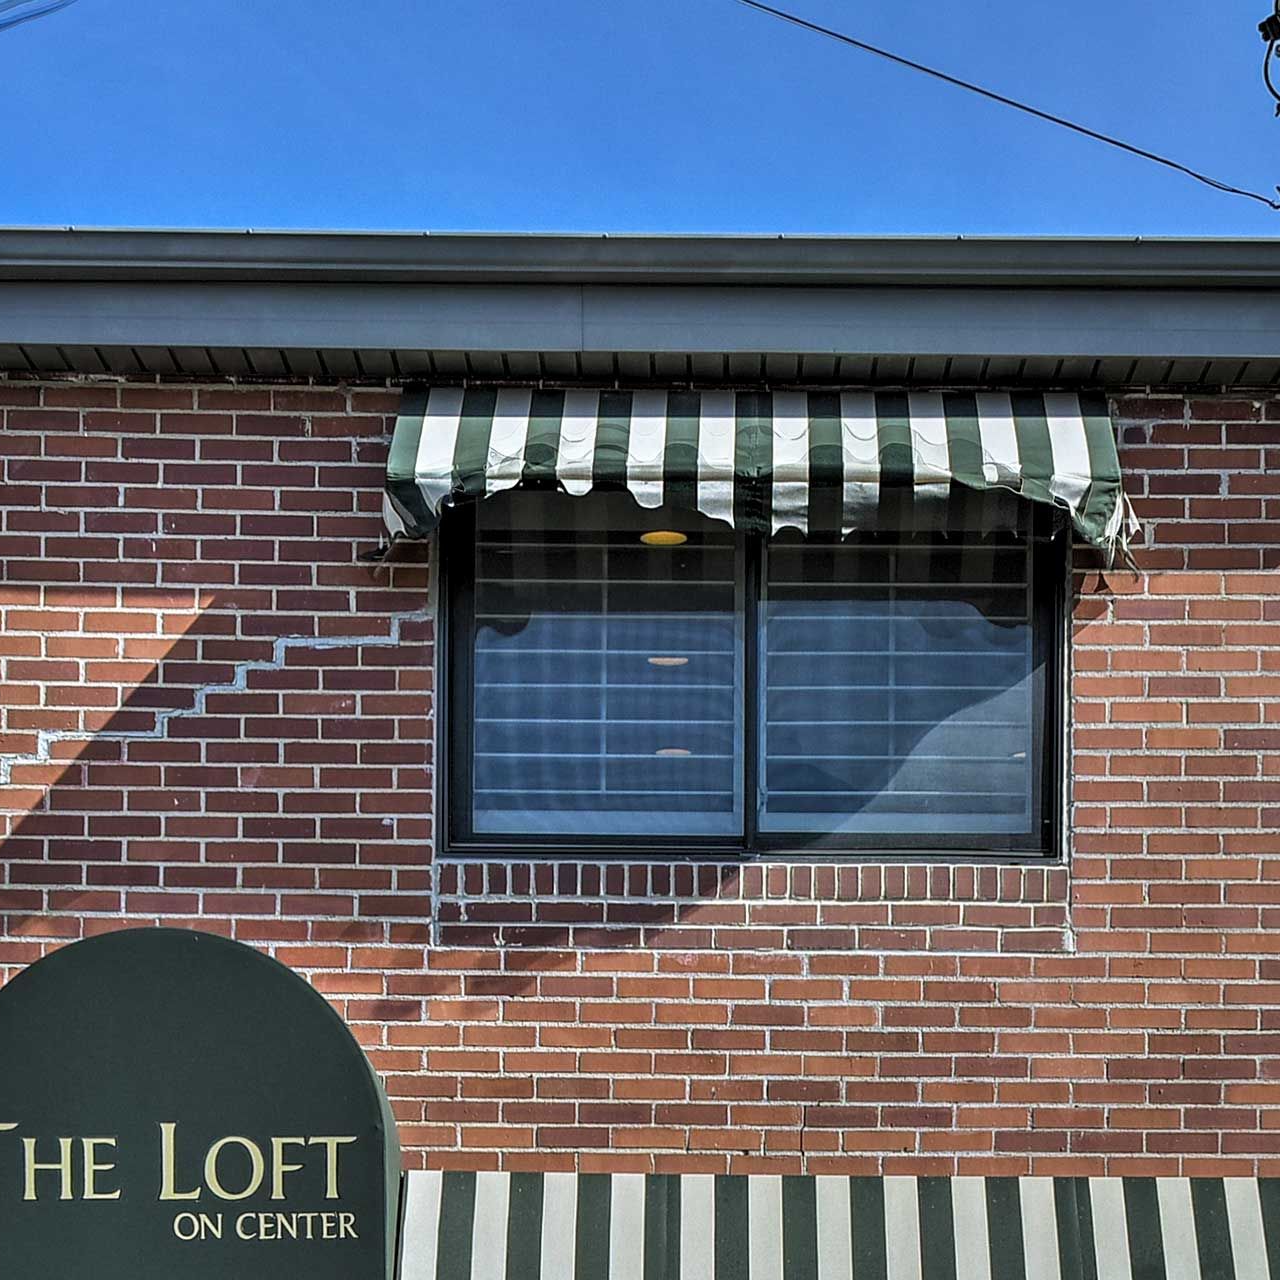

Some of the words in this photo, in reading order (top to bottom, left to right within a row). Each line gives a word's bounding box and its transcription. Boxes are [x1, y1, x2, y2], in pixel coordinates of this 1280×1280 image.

[157, 1122, 358, 1201] LOFT
[173, 1212, 223, 1241] ON
[236, 1211, 359, 1240] CENTER
